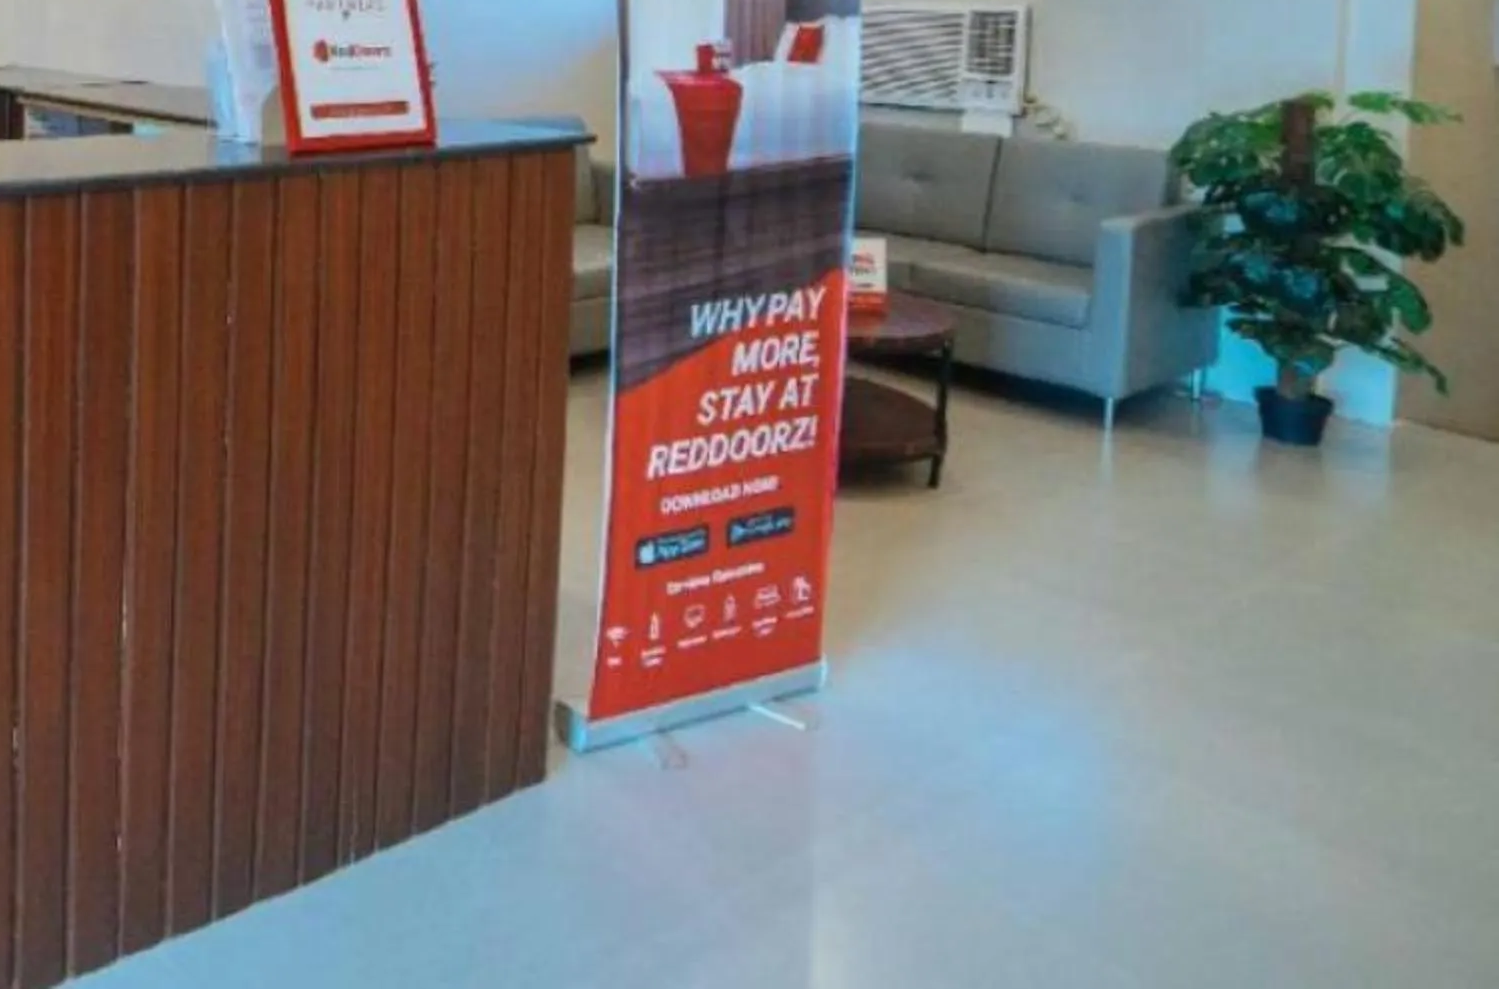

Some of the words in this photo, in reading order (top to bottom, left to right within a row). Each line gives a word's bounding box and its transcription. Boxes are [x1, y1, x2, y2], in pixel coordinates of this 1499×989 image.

[691, 295, 765, 338] WHY
[764, 285, 826, 328] PAY
[697, 380, 776, 426] STAY
[779, 373, 820, 410] AT
[647, 415, 818, 480] REDDOORZ!
